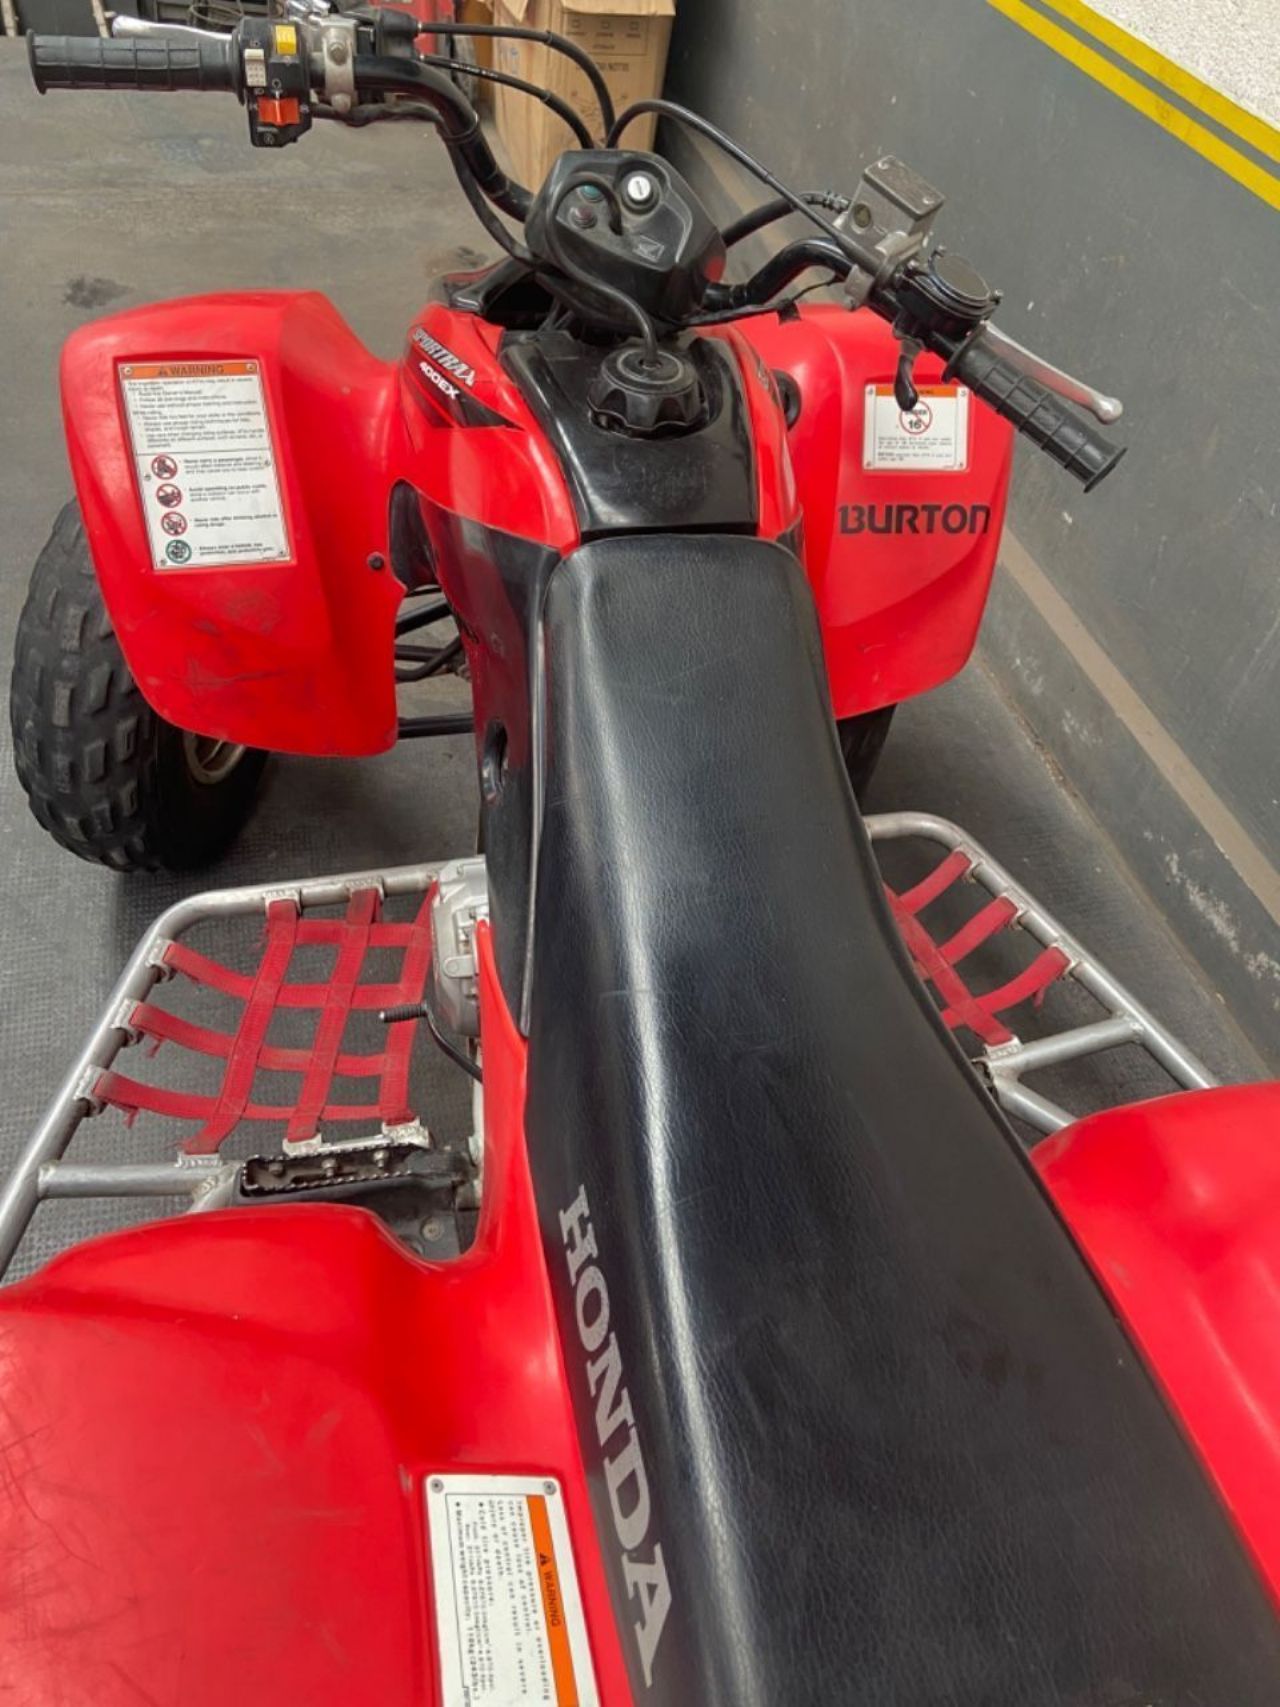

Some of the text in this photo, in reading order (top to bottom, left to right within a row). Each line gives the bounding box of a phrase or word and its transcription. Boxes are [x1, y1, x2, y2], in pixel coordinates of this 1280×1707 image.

[171, 365, 224, 375] WARNING
[412, 327, 475, 387] SPORTRAX
[419, 362, 460, 400] 400EX
[838, 503, 991, 535] BURTON
[559, 1184, 673, 1687] HONDA
[543, 1570, 561, 1626] WARNING
